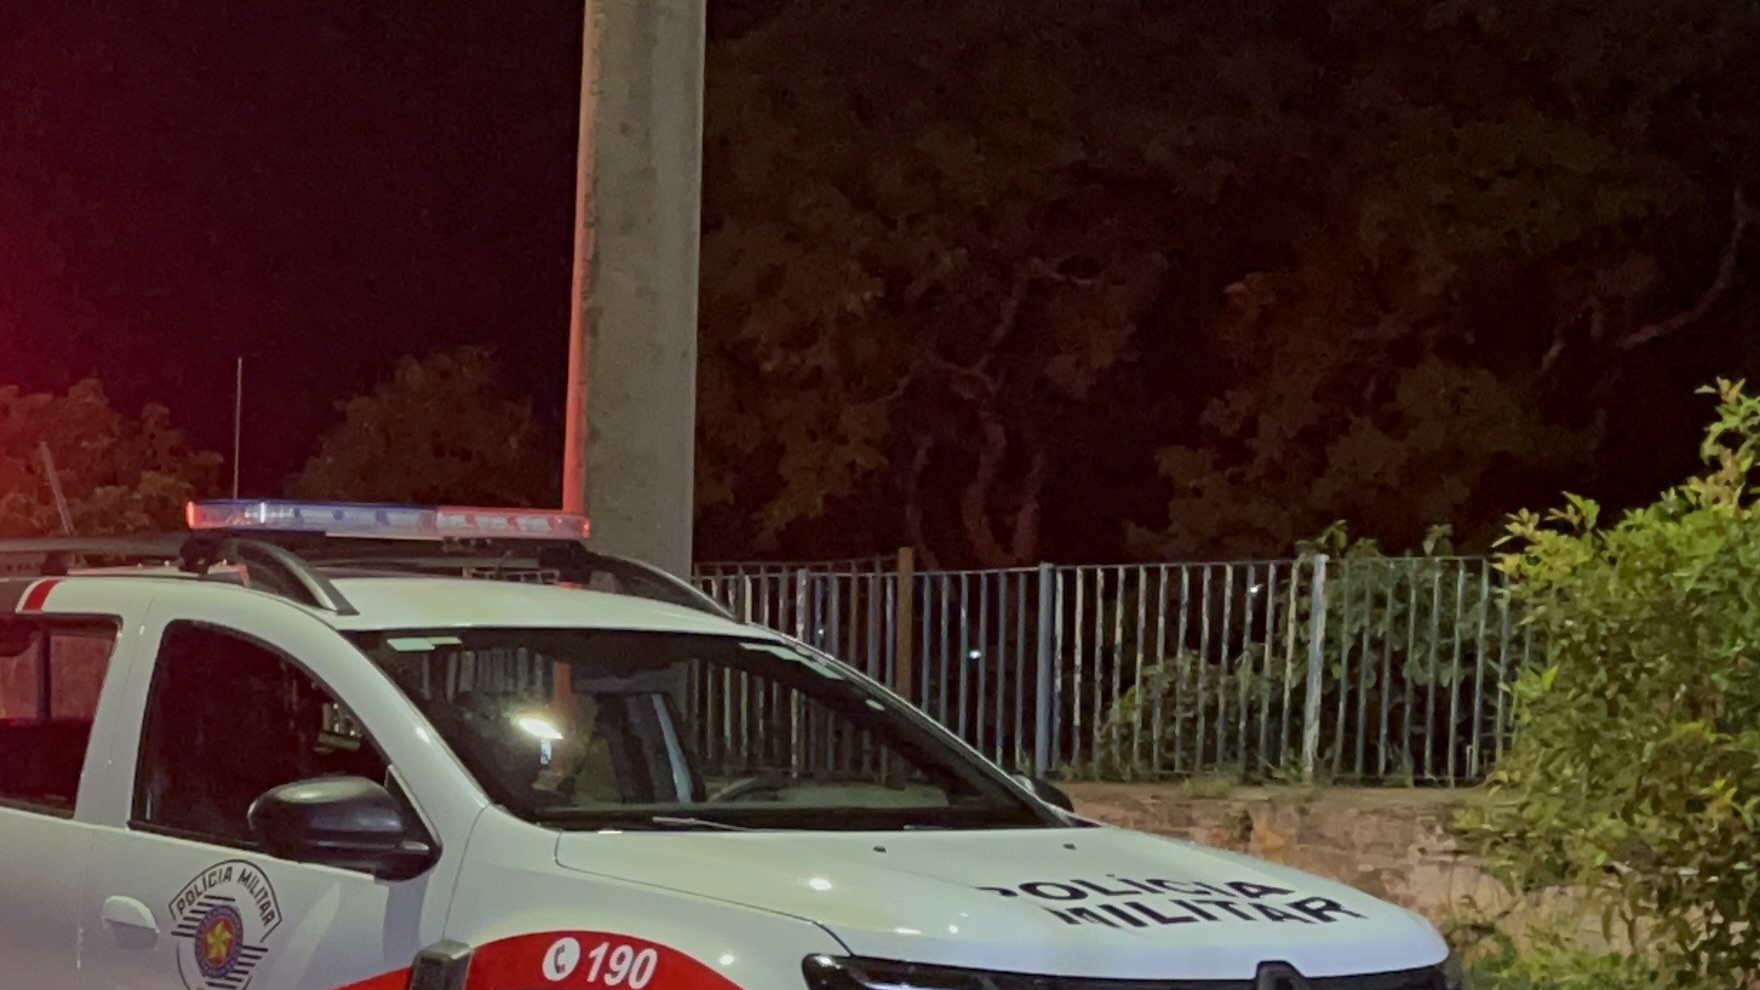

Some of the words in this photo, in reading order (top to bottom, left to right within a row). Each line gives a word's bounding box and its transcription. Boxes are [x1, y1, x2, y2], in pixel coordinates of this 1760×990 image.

[237, 868, 275, 927] MILITAR
[1040, 896, 1369, 929] MILITAR
[586, 941, 658, 990] 190
